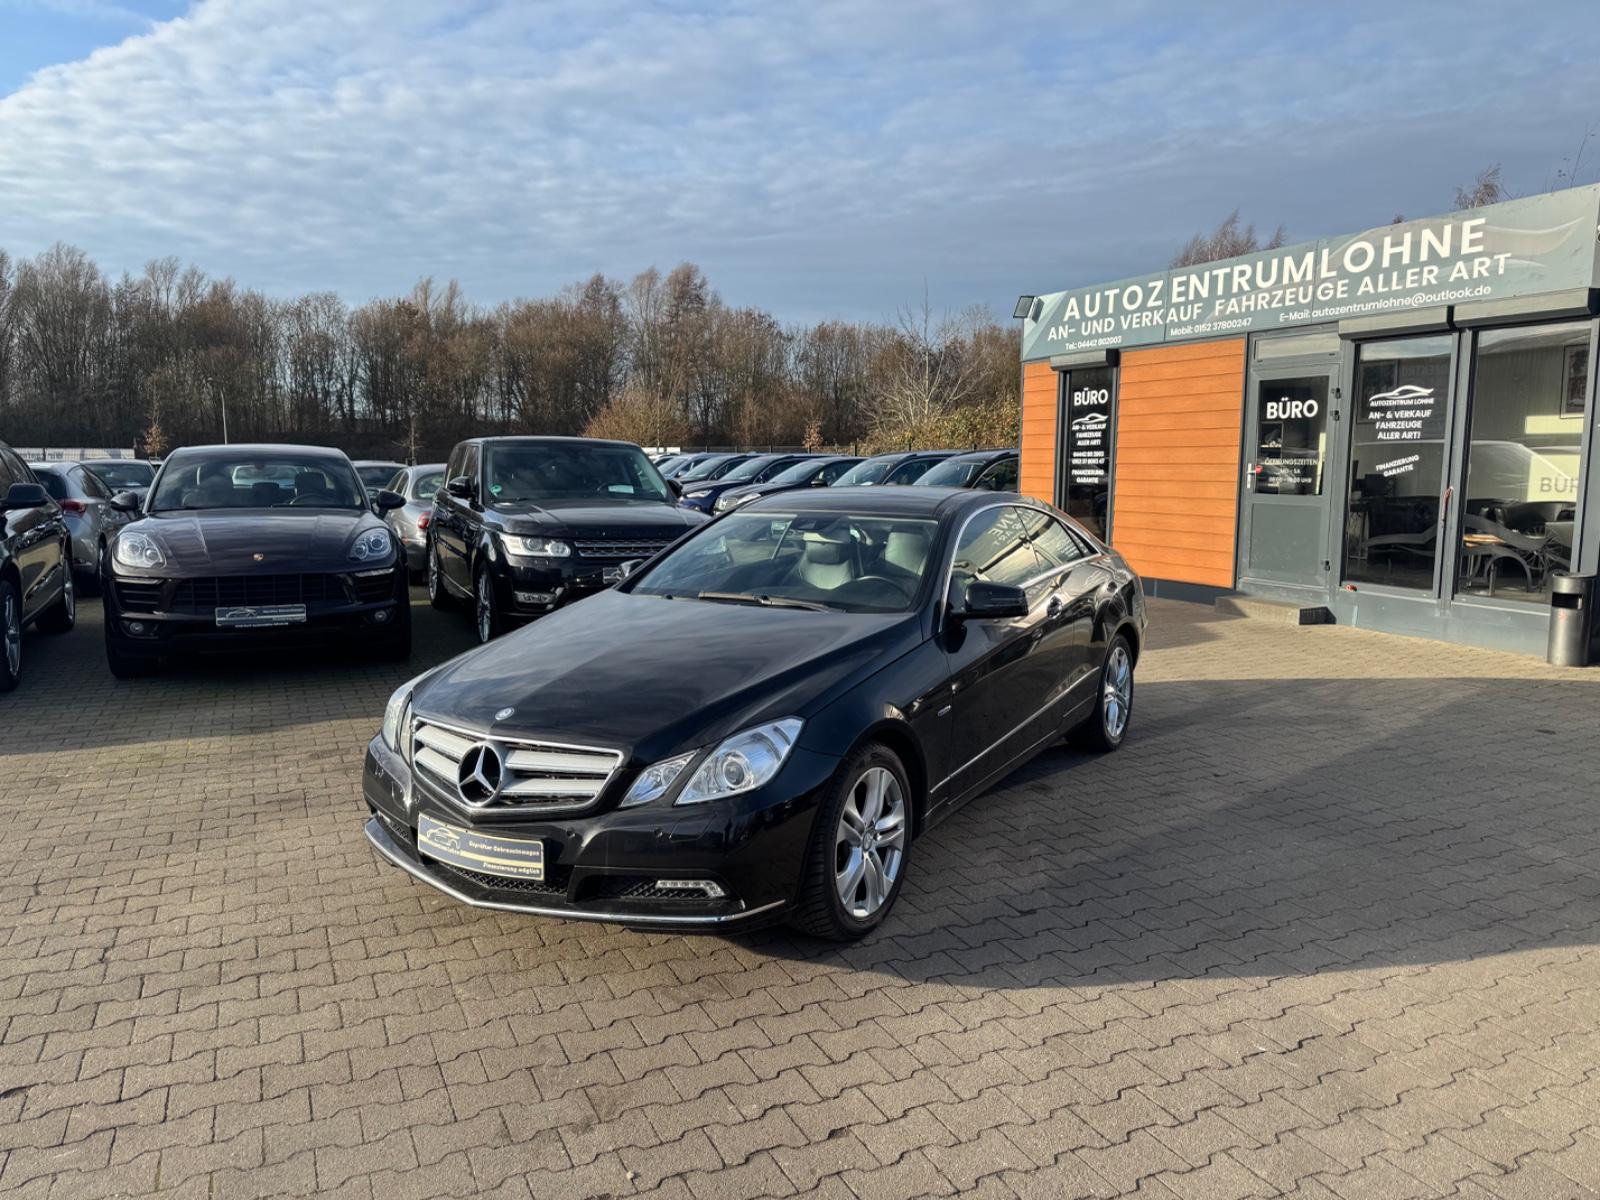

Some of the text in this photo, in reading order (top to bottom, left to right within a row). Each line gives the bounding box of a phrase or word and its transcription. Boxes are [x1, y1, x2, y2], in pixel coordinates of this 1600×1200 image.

[1047, 252, 1511, 341] AN- UND VERKAUF FAHRZEUGE ALLER ART
[1280, 285, 1492, 322] E-Mail: autozentrumlohne@outlook.de
[1073, 387, 1108, 406] BÜRO
[1370, 399, 1413, 407] AUTOZENTRUM
[1266, 397, 1318, 419] BÜRO
[1368, 409, 1432, 419] AN- & VERKAUF
[1375, 420, 1422, 430] FAHRZEUGE
[1377, 431, 1400, 440] ALLER
[1375, 455, 1420, 471] FINANZIERUNG
[1383, 464, 1414, 477] GARANTIE
